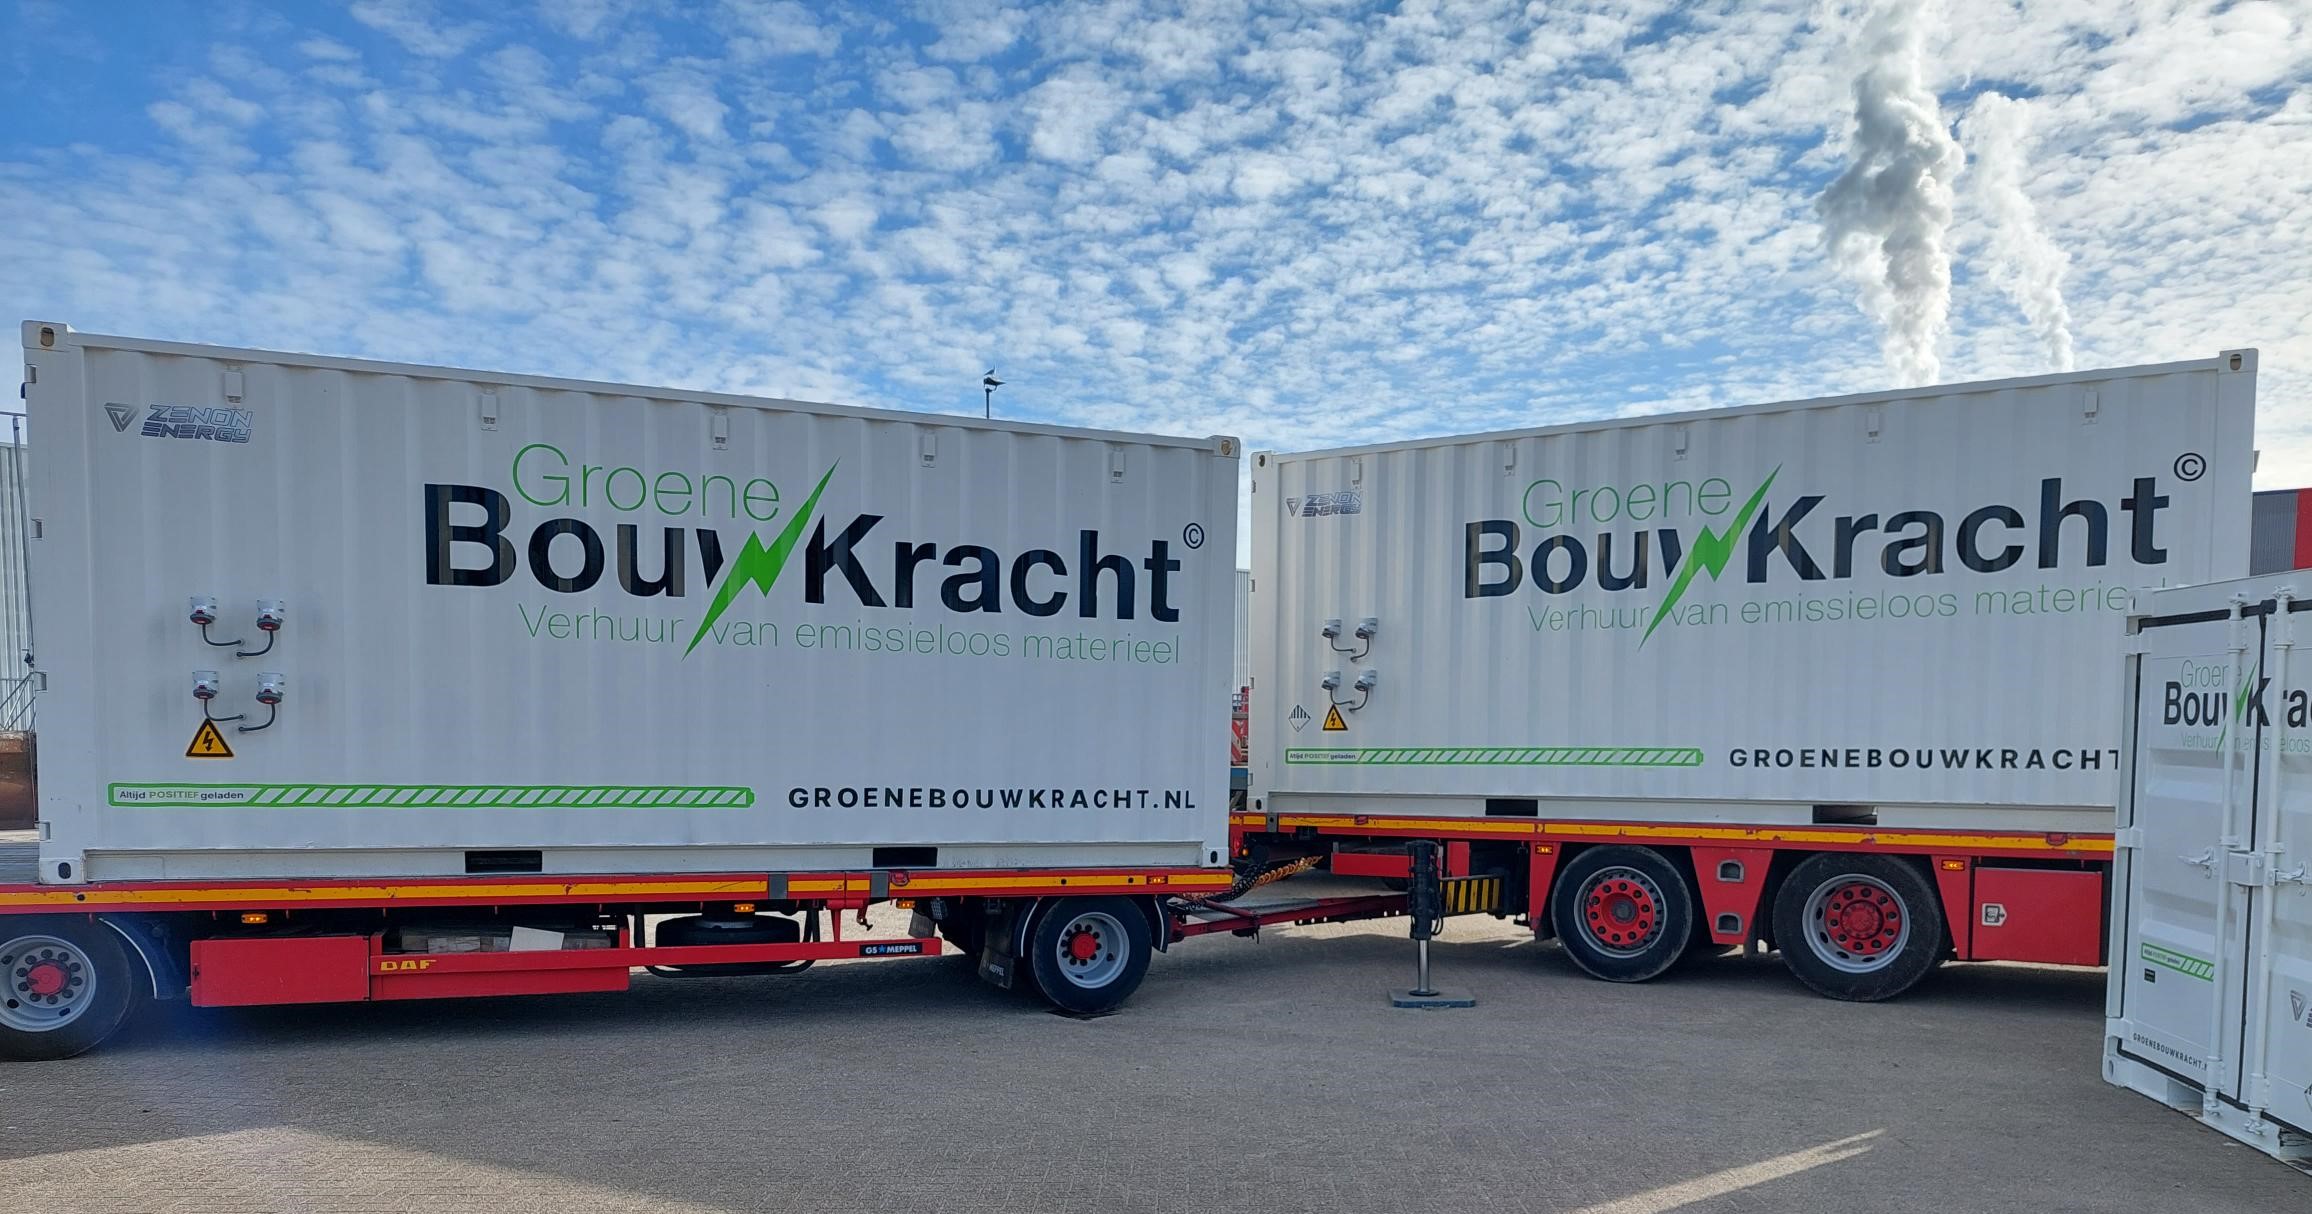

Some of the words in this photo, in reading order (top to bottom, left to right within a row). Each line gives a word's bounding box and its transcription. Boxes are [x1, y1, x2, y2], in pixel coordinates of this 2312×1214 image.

[148, 404, 253, 428] ZENON
[141, 422, 251, 443] ENERGY
[511, 443, 780, 522] Groene
[1520, 476, 1732, 529] Groene
[1528, 603, 1650, 632] Verhuur
[1668, 601, 1728, 626] van
[1740, 590, 1957, 625] emissieloos
[518, 603, 684, 643] Verhuur
[711, 611, 778, 647] van
[795, 624, 1010, 656] emissieloos
[1023, 633, 1180, 664] materieel
[119, 790, 146, 801] Altijd
[149, 791, 199, 799] POSITIEF
[200, 791, 244, 801] geladen
[788, 787, 1196, 809] GROENEBOUWKRACHT.NL
[886, 945, 917, 953] MEPPEL
[380, 959, 437, 971] DAF
